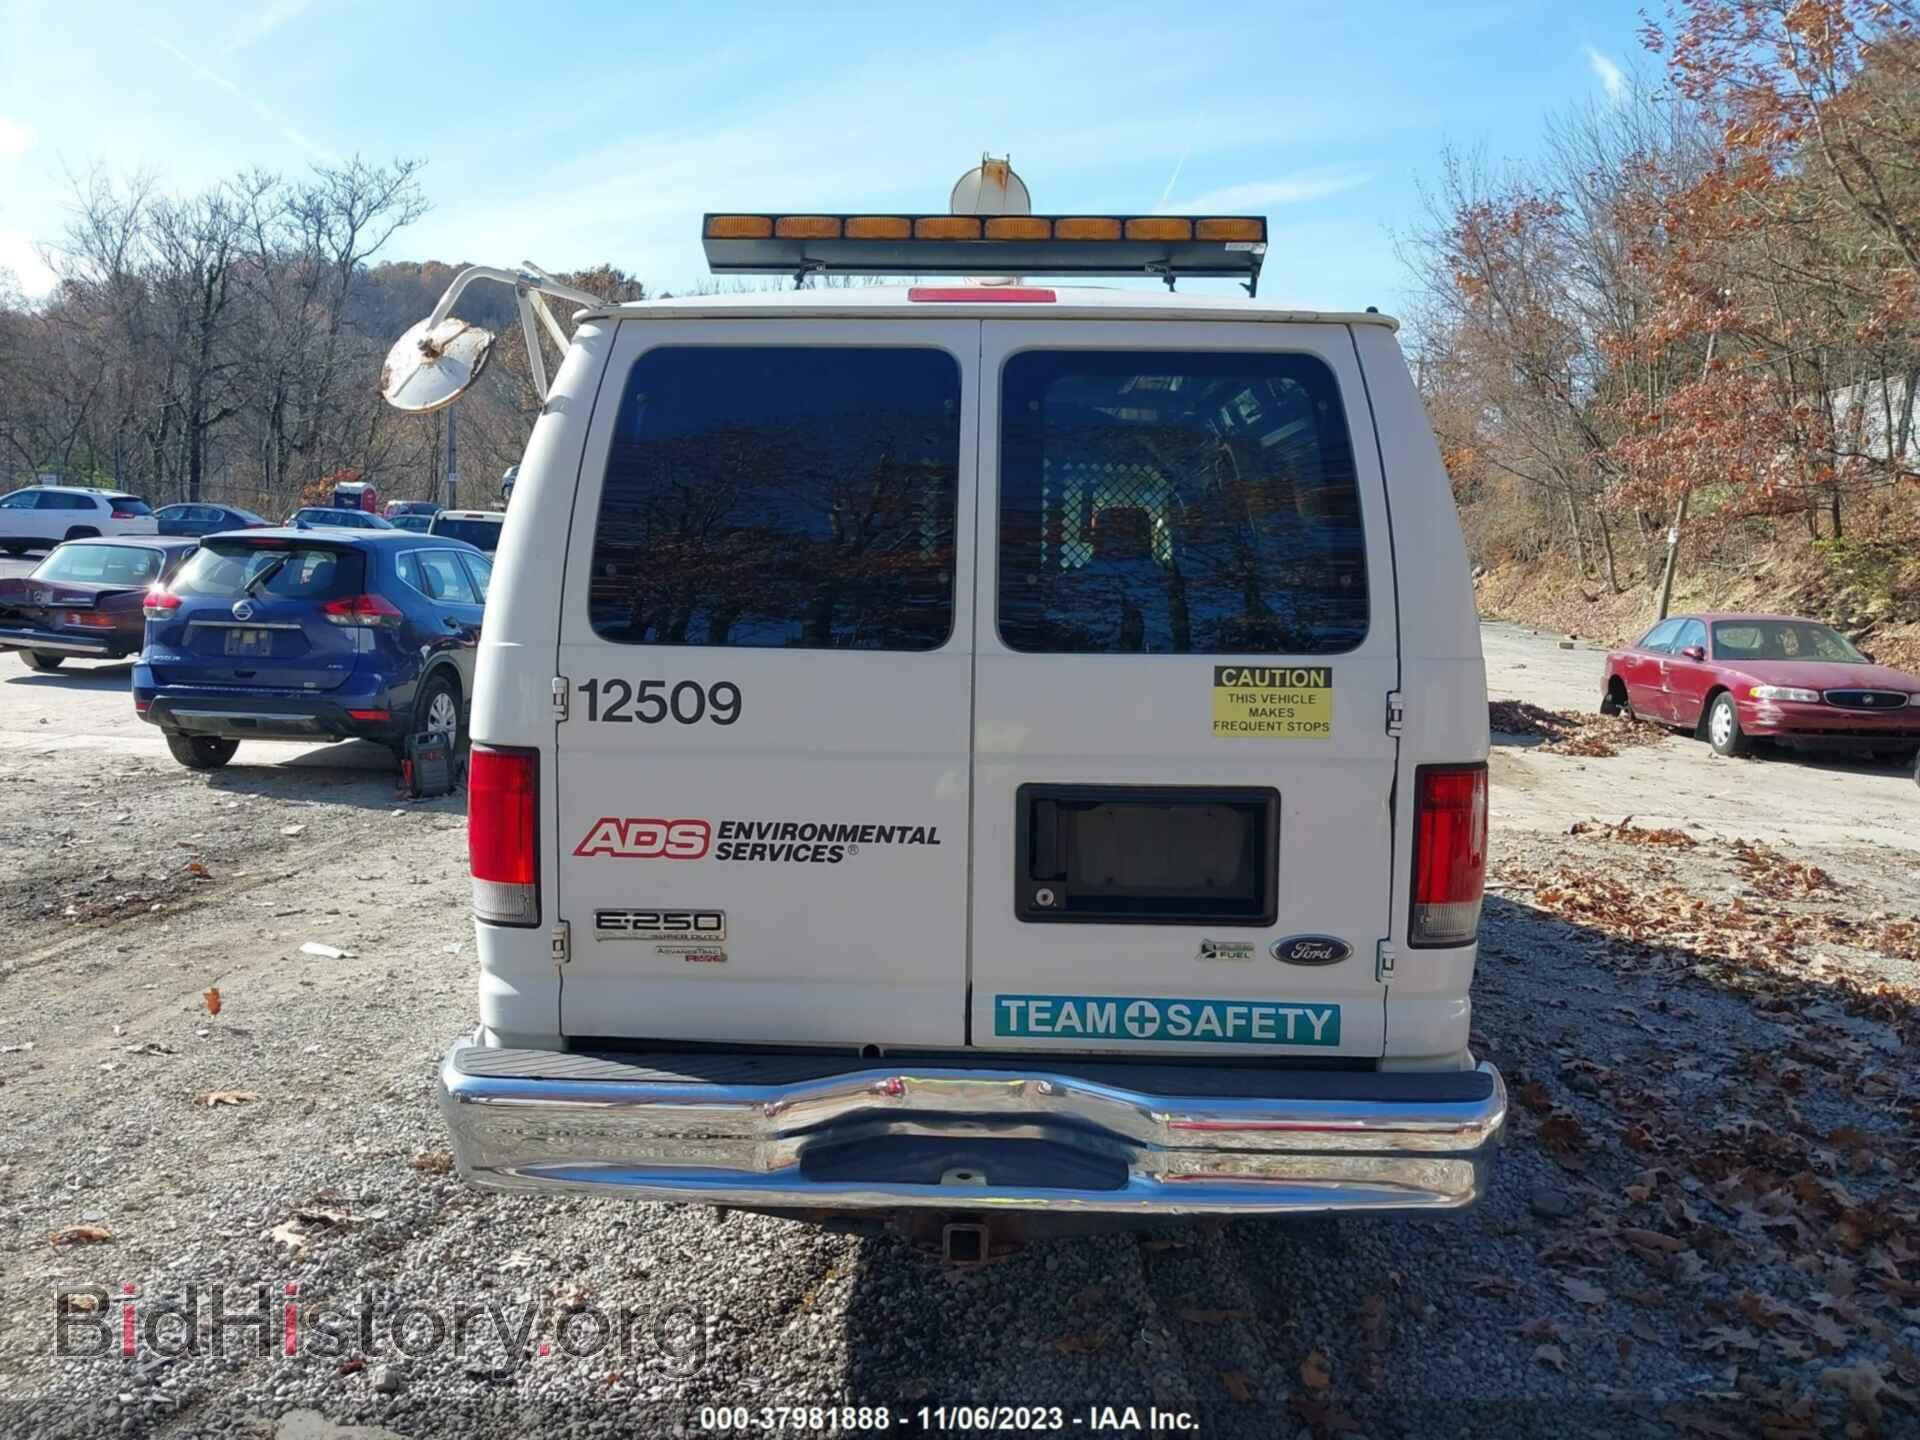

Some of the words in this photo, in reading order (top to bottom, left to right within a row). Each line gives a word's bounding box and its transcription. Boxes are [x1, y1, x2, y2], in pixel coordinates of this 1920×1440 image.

[1221, 668, 1325, 687] CAUTION
[577, 678, 743, 726] 12509
[1228, 693, 1257, 704] THIS
[1260, 693, 1317, 705] VEHICLE
[1248, 707, 1296, 718] MAKES
[1213, 721, 1283, 732] FREQUENT
[1287, 721, 1330, 732] STOPS
[573, 817, 712, 860] ADS
[717, 820, 941, 845] ENVIRONMENTAL
[596, 911, 722, 930] E-250
[1291, 941, 1332, 959] Ford
[1001, 1000, 1116, 1034] TEAM
[1166, 1004, 1334, 1041] SAFETY
